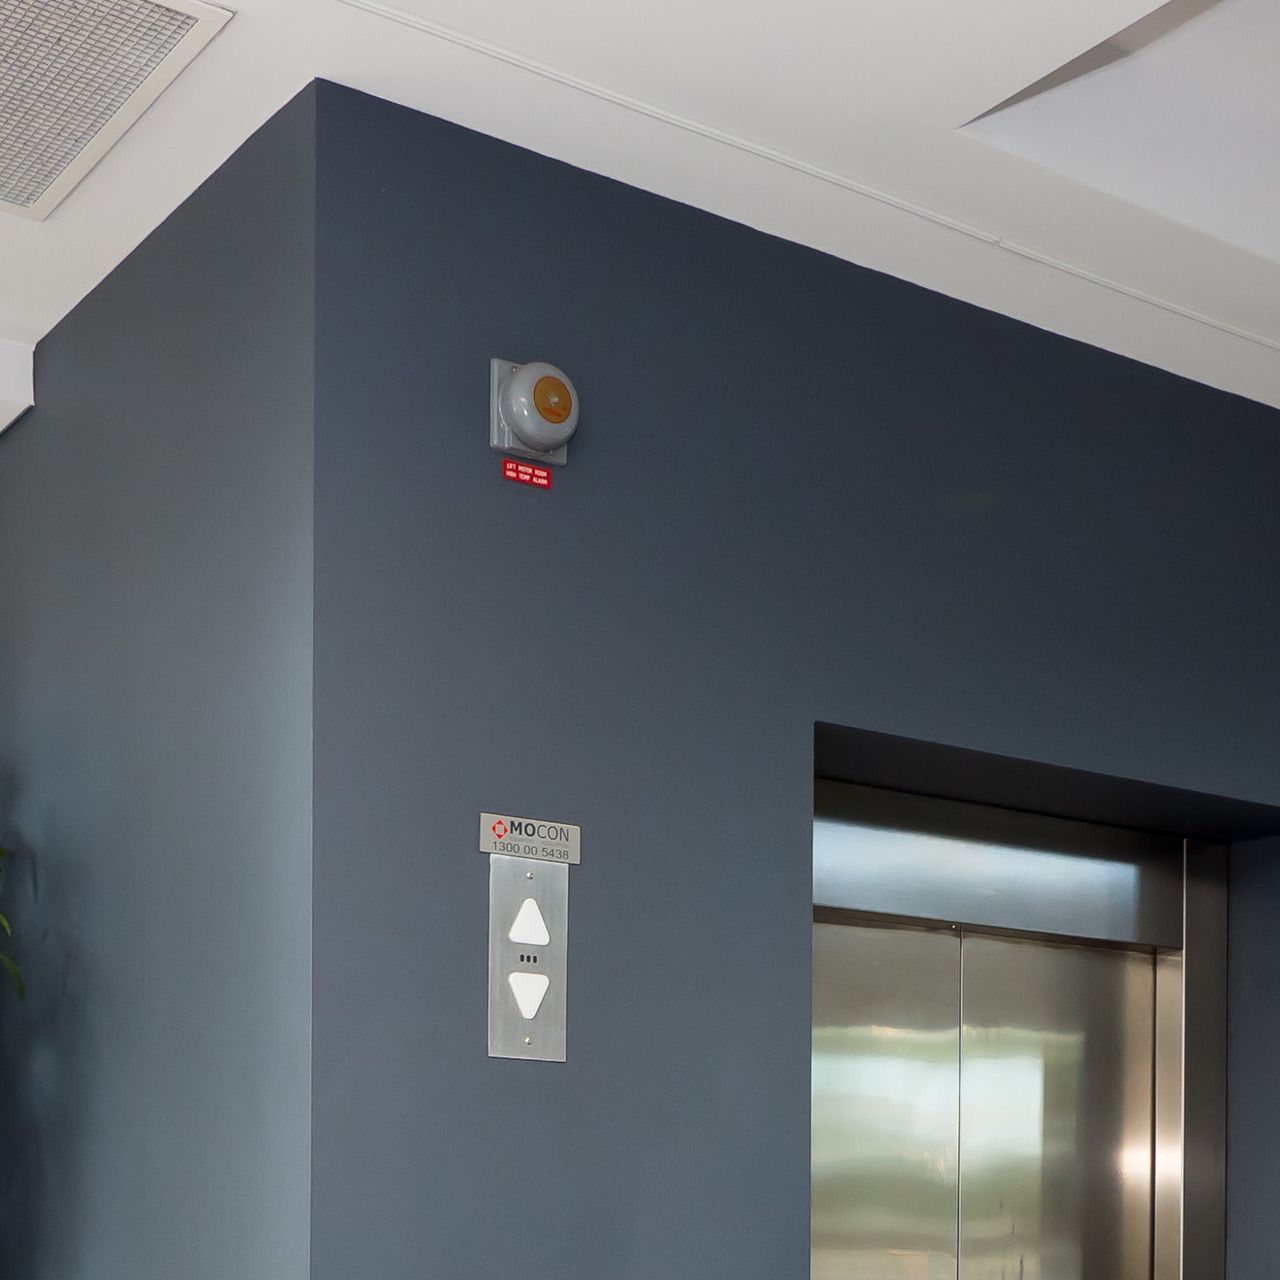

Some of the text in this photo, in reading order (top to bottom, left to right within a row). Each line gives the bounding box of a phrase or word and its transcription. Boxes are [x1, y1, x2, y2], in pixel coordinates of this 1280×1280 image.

[509, 820, 569, 842] MOCON
[492, 841, 520, 854] 1300
[523, 844, 538, 856] 00
[541, 847, 569, 860] 5438
